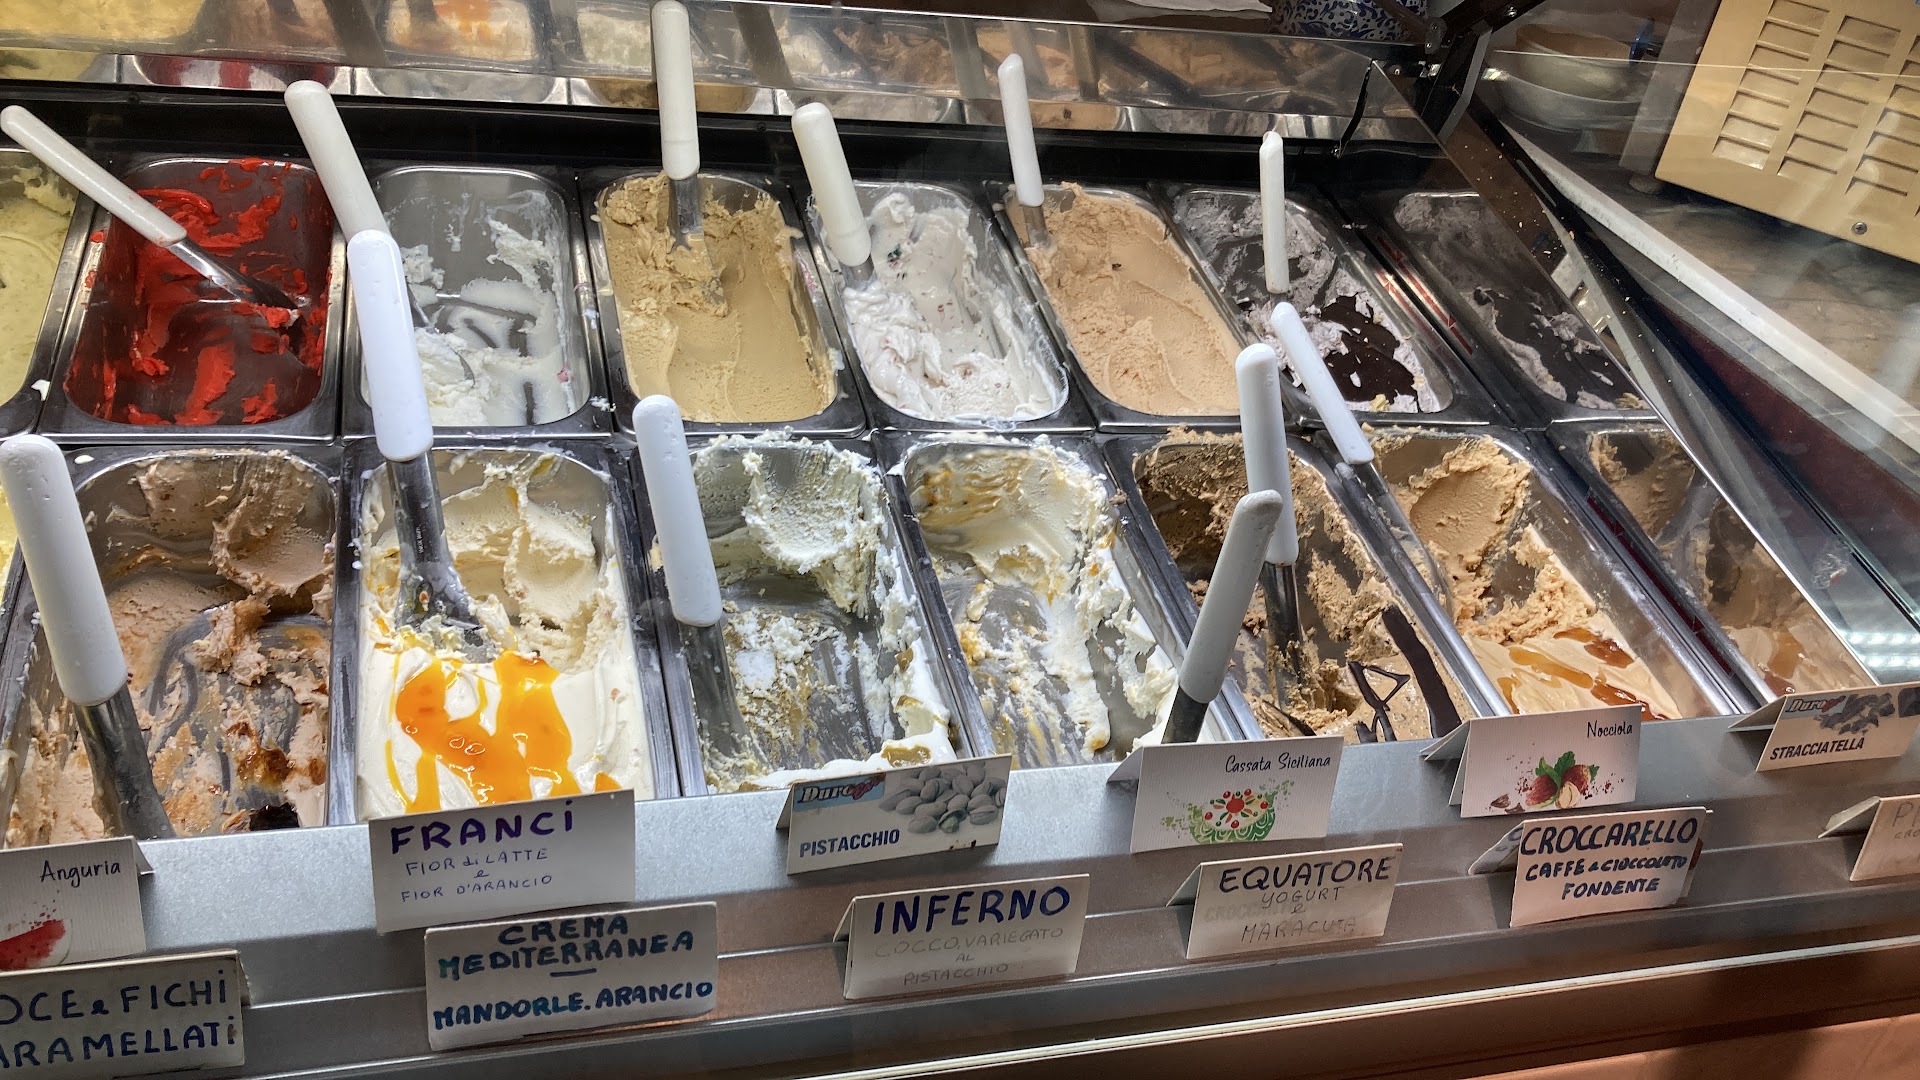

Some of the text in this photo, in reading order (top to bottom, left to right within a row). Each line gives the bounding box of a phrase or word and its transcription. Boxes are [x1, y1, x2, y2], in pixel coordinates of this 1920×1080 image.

[1587, 720, 1633, 739] Nocciola
[1770, 737, 1865, 761] STRACCIATELLA
[1225, 752, 1331, 773] Cassata Siciliana
[800, 828, 900, 858] PISTACCHIO
[1520, 817, 1698, 855] CROCCARELLO
[40, 860, 121, 888] Anguria
[405, 848, 548, 876] FIOR di LATTE
[474, 869, 490, 878] e
[1525, 858, 1585, 881] CAFFE
[1219, 856, 1396, 893] EQUATORE
[401, 875, 553, 902] FIOR D'ARANCIO
[1262, 886, 1345, 909] YOGURT
[1561, 877, 1660, 900] FONDENTE
[873, 885, 1070, 935] INFERNO
[1290, 903, 1305, 914] e
[498, 914, 629, 946] CREMA
[438, 930, 694, 981] MEDITERRANEA
[955, 952, 975, 962] AL
[903, 963, 1009, 985] PISTACCHIO
